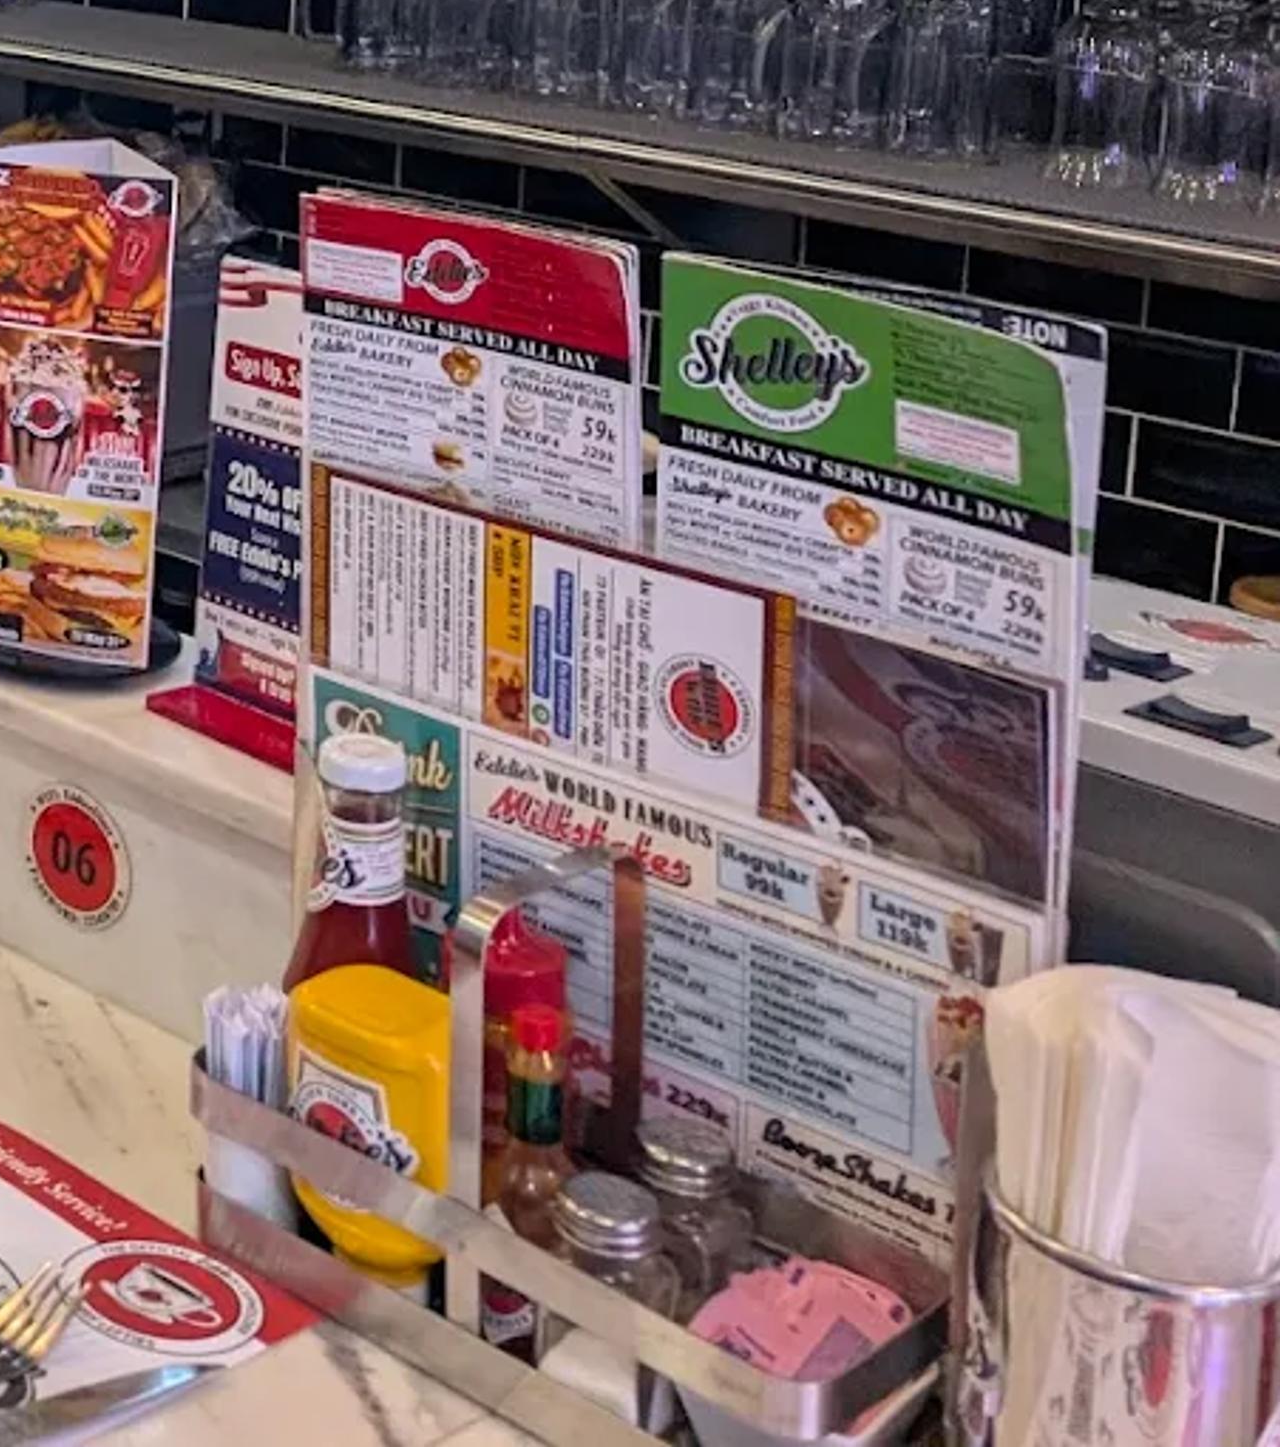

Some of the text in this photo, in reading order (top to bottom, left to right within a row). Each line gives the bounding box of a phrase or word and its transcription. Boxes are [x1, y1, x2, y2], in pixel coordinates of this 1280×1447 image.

[323, 300, 602, 373] BREAKFAST SERVED ALL DAY
[394, 334, 440, 356] FROM
[1001, 314, 1069, 350] NOTE:
[230, 347, 261, 378] Sign
[358, 346, 416, 370] BAKERY
[683, 332, 866, 401] Shelley's
[499, 375, 616, 416] CINNAMON BUNS
[226, 459, 280, 503] 20%
[666, 457, 824, 506] FRESH DAILY FROM
[680, 424, 1031, 533] BREAKFAST SERVED ALL DAY
[736, 494, 804, 523] BAKERY
[208, 528, 240, 560] FREE
[898, 536, 1046, 592] CINNAMON BUNS
[907, 524, 1042, 574] WORLD FAMOUS
[899, 589, 940, 616] PACK
[941, 599, 966, 621] OF
[474, 750, 541, 786] Eddie's
[542, 768, 617, 815] WORLD
[622, 797, 714, 851] FAMOUS
[51, 830, 96, 887] 06
[487, 784, 693, 888] Milkshkes
[721, 840, 810, 887] Regular
[743, 870, 786, 903] 99k
[868, 893, 937, 934] Large
[874, 919, 929, 954] 119k
[40, 1176, 130, 1236] Service!
[842, 1152, 937, 1217] Shakes
